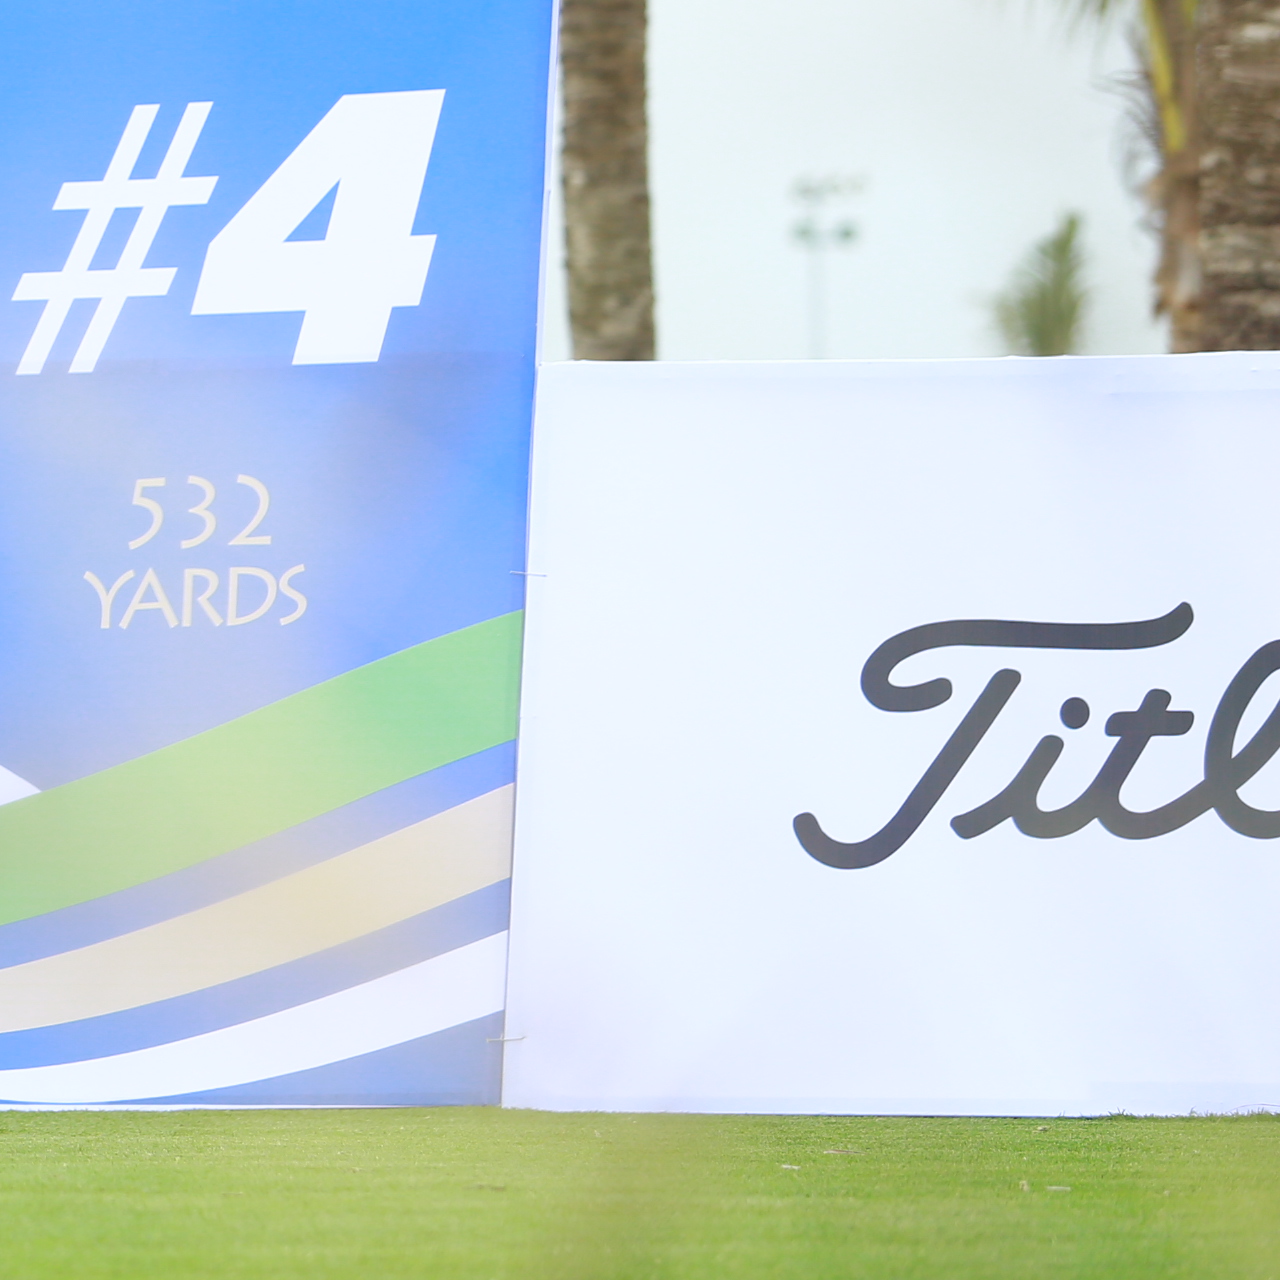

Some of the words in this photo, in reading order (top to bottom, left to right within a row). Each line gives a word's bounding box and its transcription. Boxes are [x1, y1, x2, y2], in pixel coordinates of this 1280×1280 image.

[11, 88, 446, 375] #4
[128, 474, 272, 550] 532
[83, 563, 308, 630] YARDS
